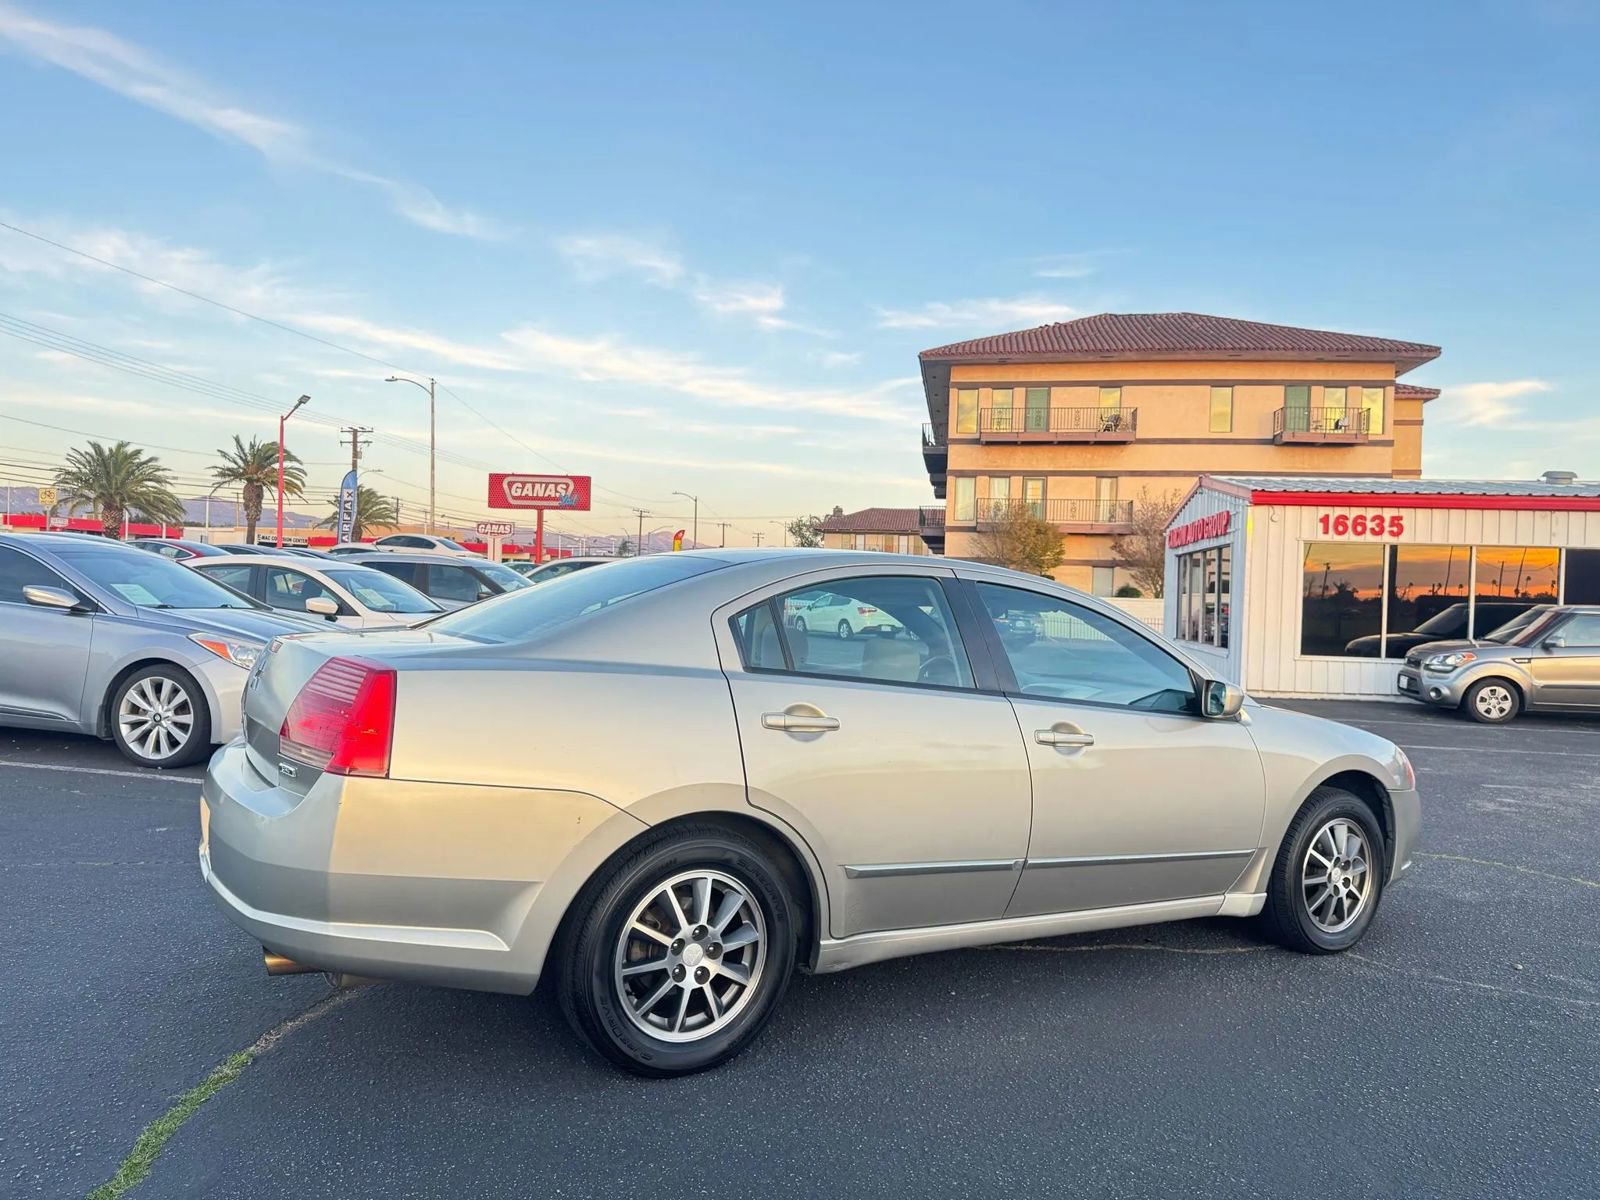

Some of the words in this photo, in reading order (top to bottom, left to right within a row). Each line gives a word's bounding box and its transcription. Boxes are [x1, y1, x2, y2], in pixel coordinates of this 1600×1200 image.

[511, 482, 567, 497] GANAS
[342, 491, 354, 542] ARFAX
[1187, 519, 1204, 543] AUTO
[1204, 510, 1231, 538] GROUP
[1319, 513, 1404, 537] 16635
[478, 524, 511, 534] GANAS
